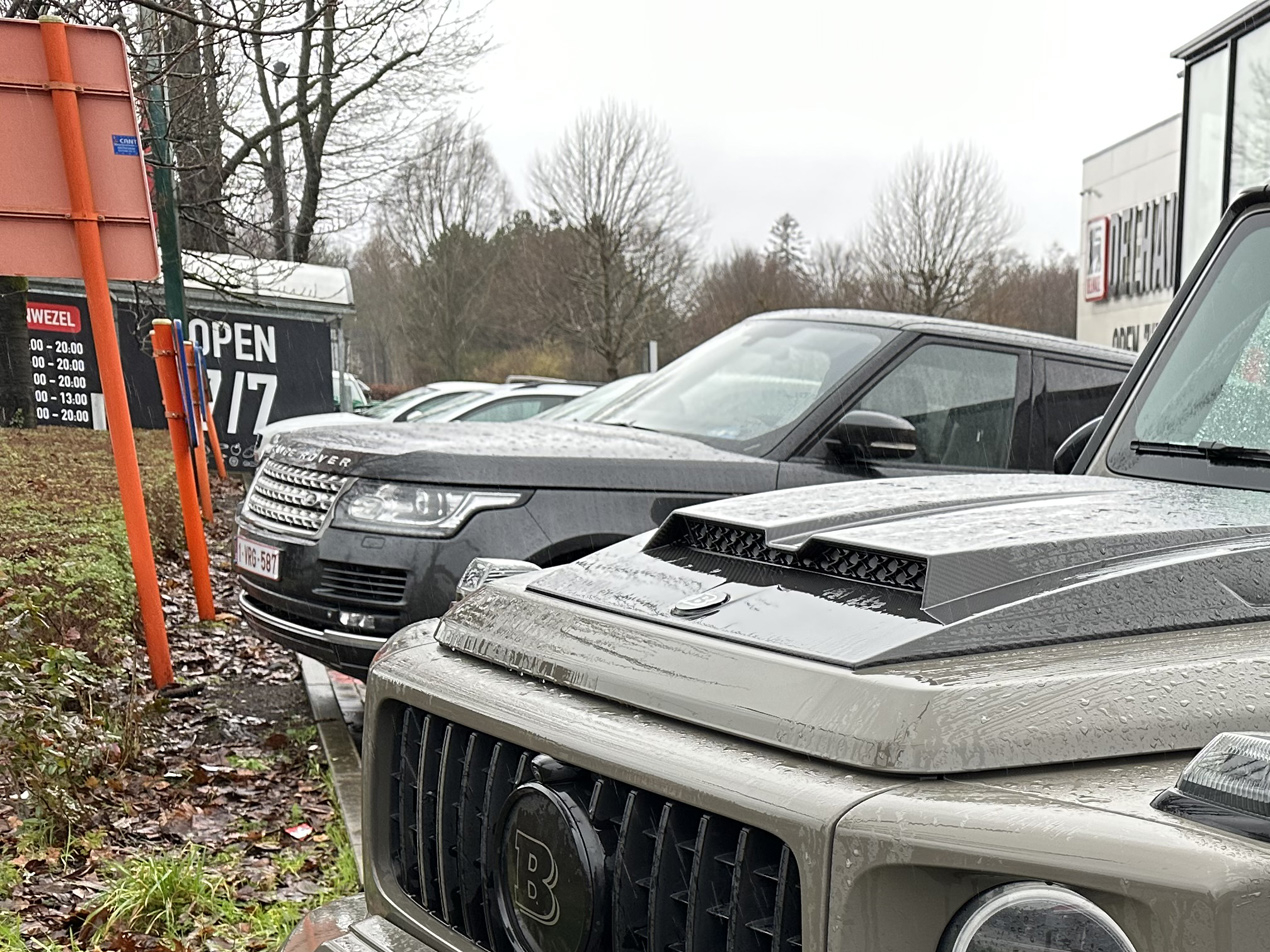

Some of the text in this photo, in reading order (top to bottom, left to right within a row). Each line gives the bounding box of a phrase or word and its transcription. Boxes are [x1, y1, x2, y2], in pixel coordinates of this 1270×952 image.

[55, 341, 84, 355] 20:00
[189, 318, 277, 364] OPEN
[56, 358, 85, 372] 20:00
[58, 375, 87, 389] 20:00
[60, 392, 88, 406] 13:00
[61, 409, 89, 423] 20:00
[238, 543, 277, 575] 1-VRG-587
[514, 829, 561, 926] B
